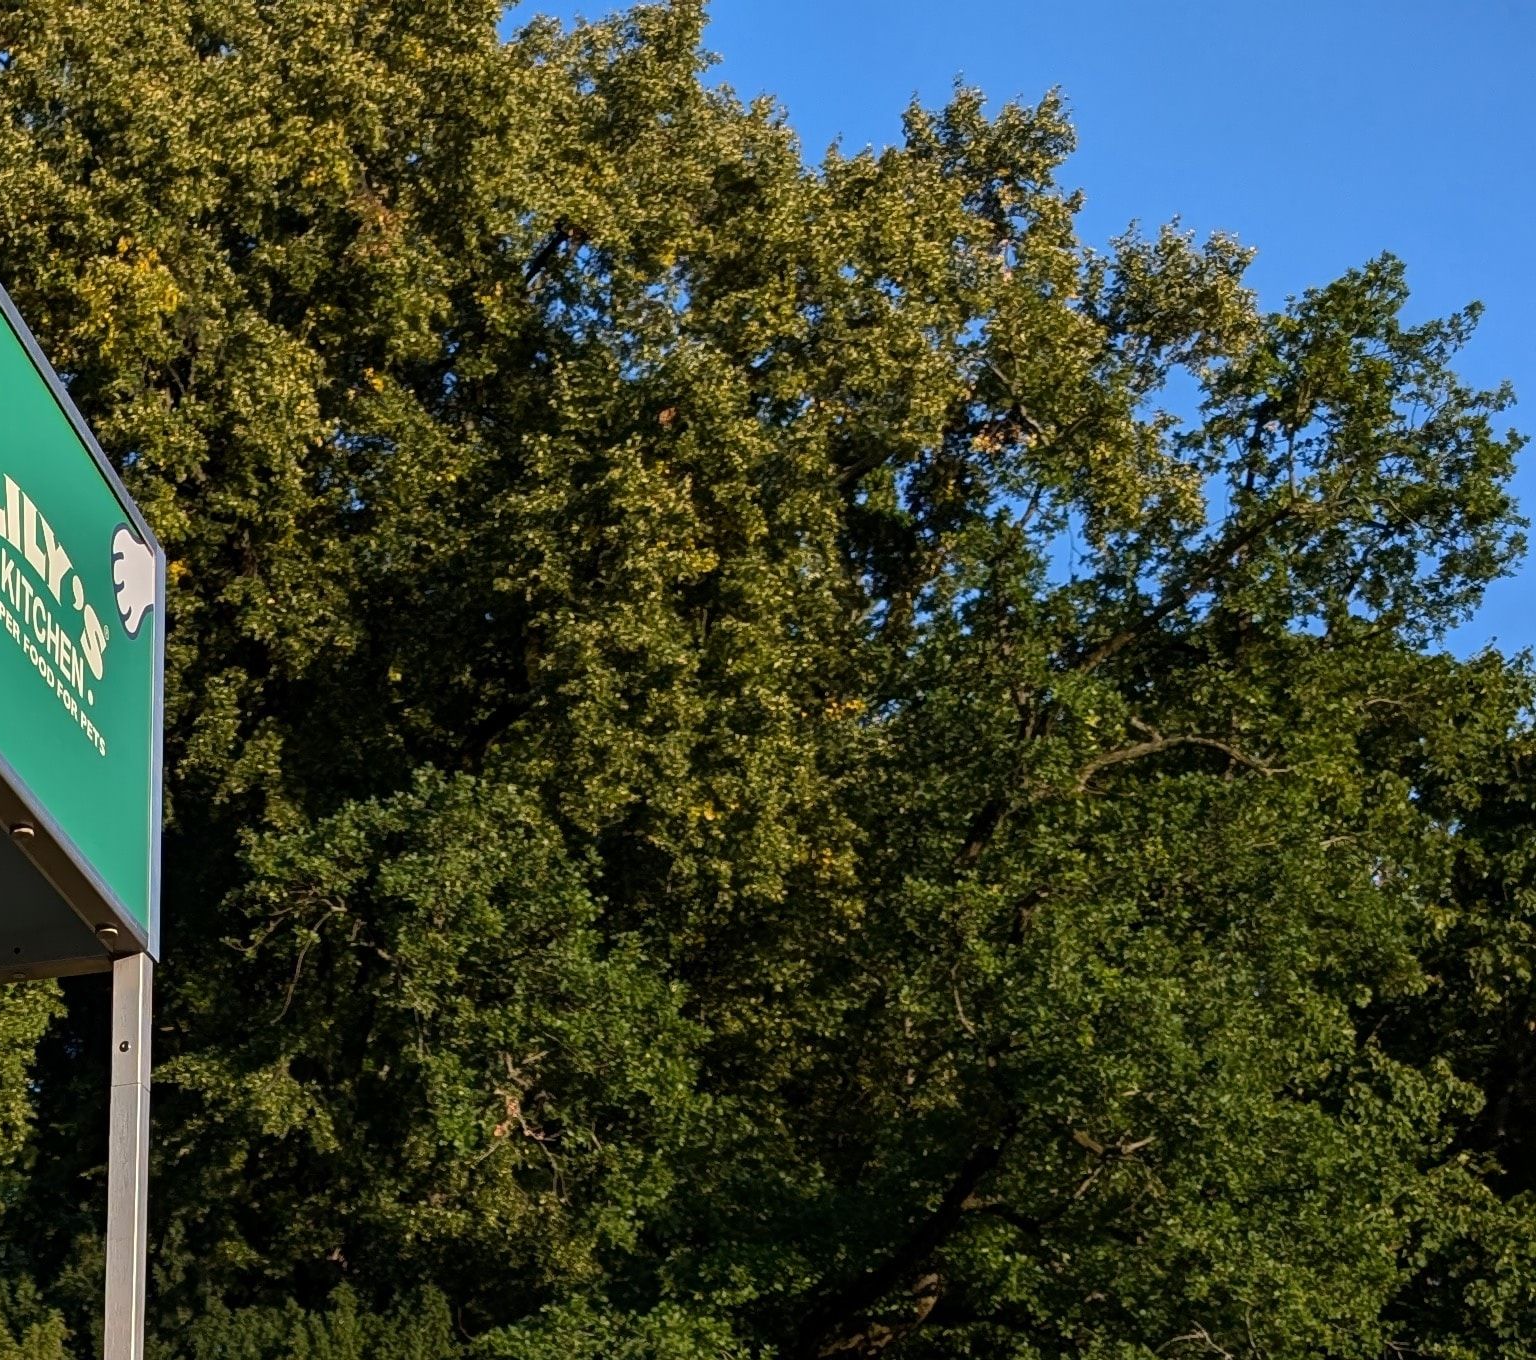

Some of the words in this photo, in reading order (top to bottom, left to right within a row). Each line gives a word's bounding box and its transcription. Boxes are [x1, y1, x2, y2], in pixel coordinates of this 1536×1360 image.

[0, 548, 85, 699] KITCHEN
[23, 634, 55, 689] FOOD
[56, 678, 79, 725] FOR
[80, 709, 106, 757] PETS
